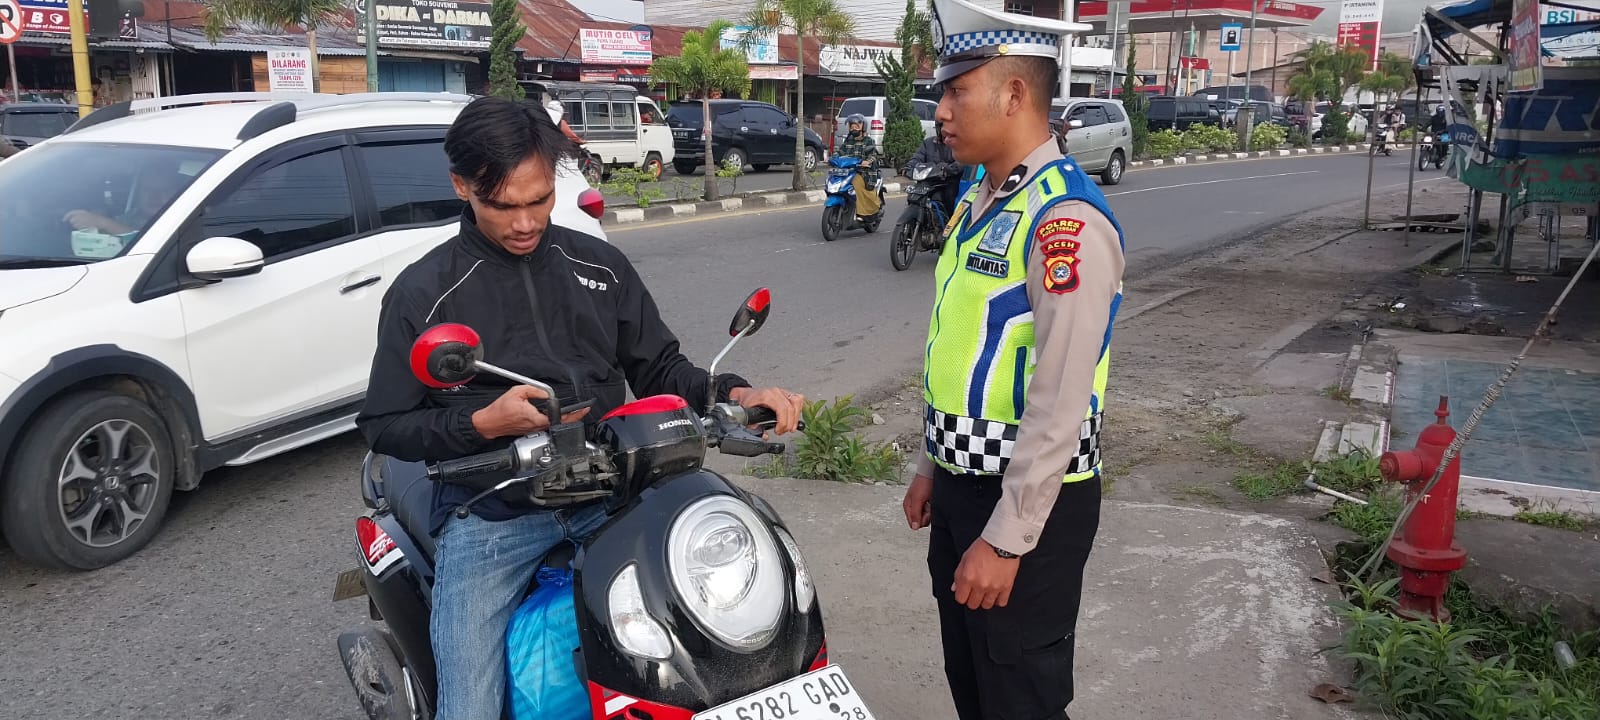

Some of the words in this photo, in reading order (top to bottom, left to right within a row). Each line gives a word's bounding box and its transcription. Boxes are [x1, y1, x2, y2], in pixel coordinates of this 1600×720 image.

[375, 5, 421, 23] DIKA
[433, 9, 493, 26] DARMA
[1547, 10, 1575, 24] BSI
[843, 47, 887, 61] NAJWA
[271, 59, 306, 68] DILARANG
[1039, 220, 1080, 236] POLRES
[1047, 241, 1075, 250] ACEH
[658, 419, 693, 430] HONDA
